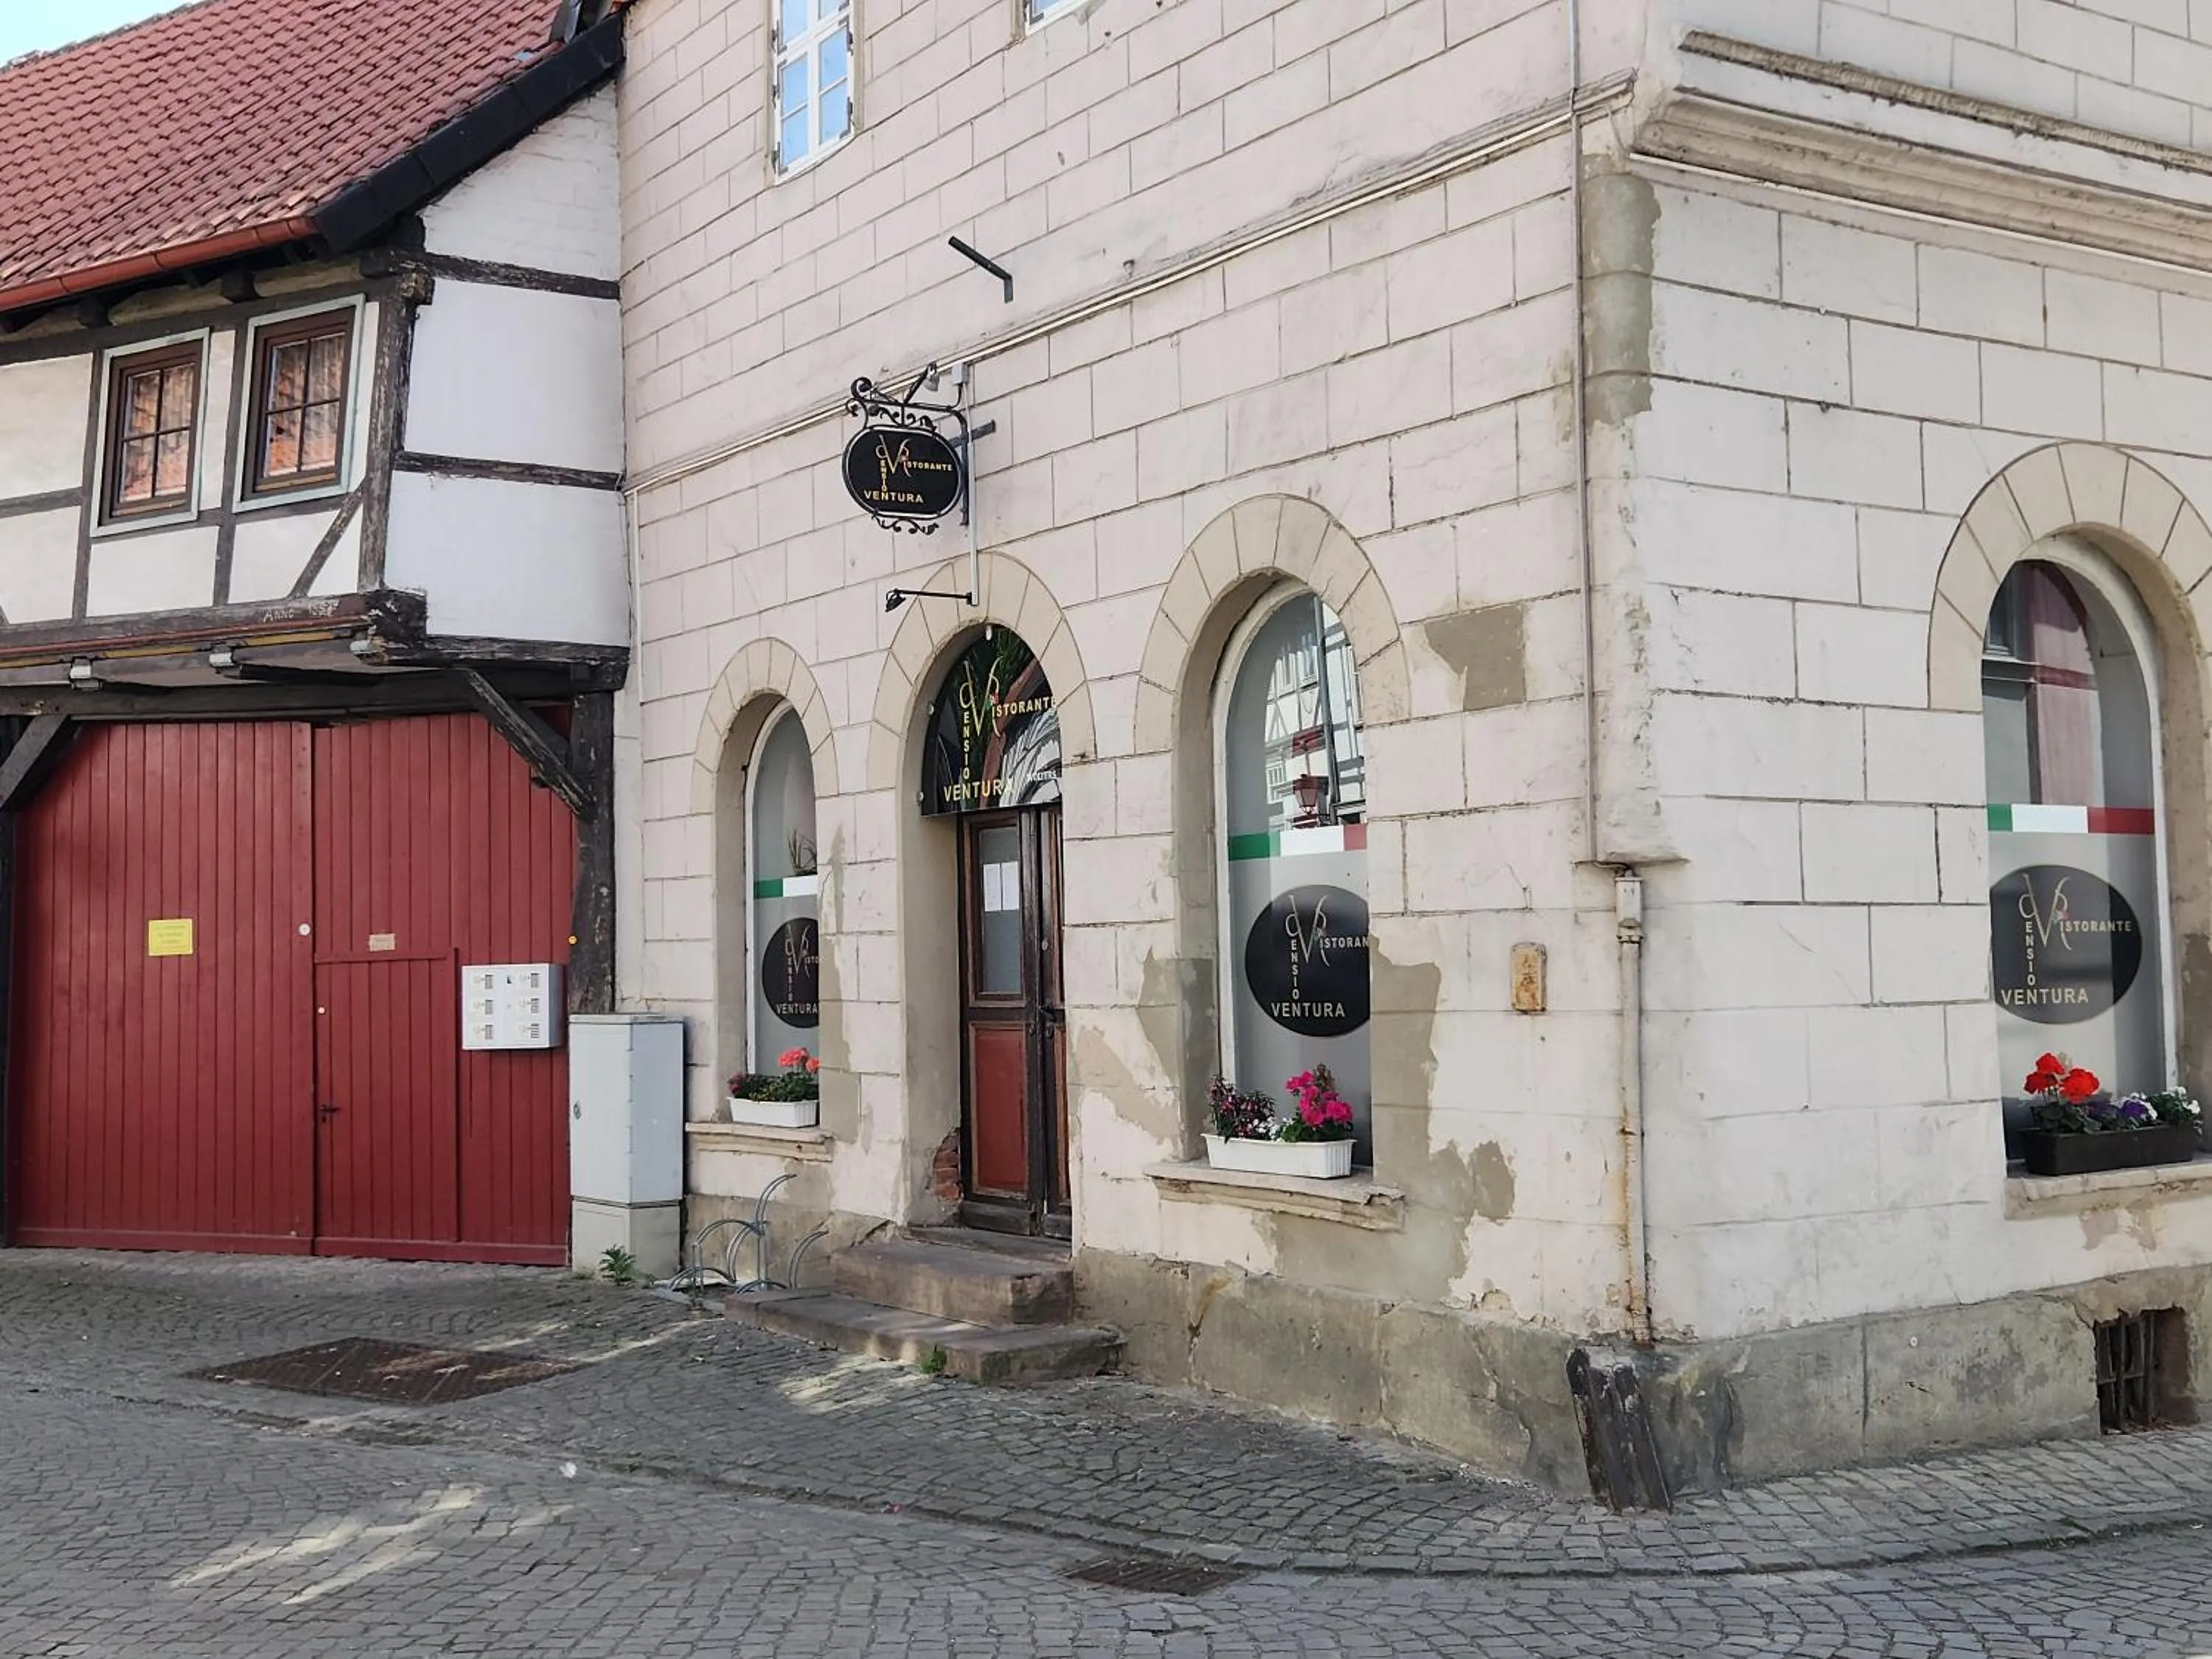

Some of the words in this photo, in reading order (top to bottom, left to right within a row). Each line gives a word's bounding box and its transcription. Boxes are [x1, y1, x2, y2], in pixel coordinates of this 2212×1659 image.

[863, 490, 924, 504] VENTURA
[944, 778, 1013, 802] VENTURA
[2000, 988, 2089, 1005] VENTURA
[776, 1003, 818, 1015] VENTURA
[1270, 1002, 1346, 1018] VENTURA
